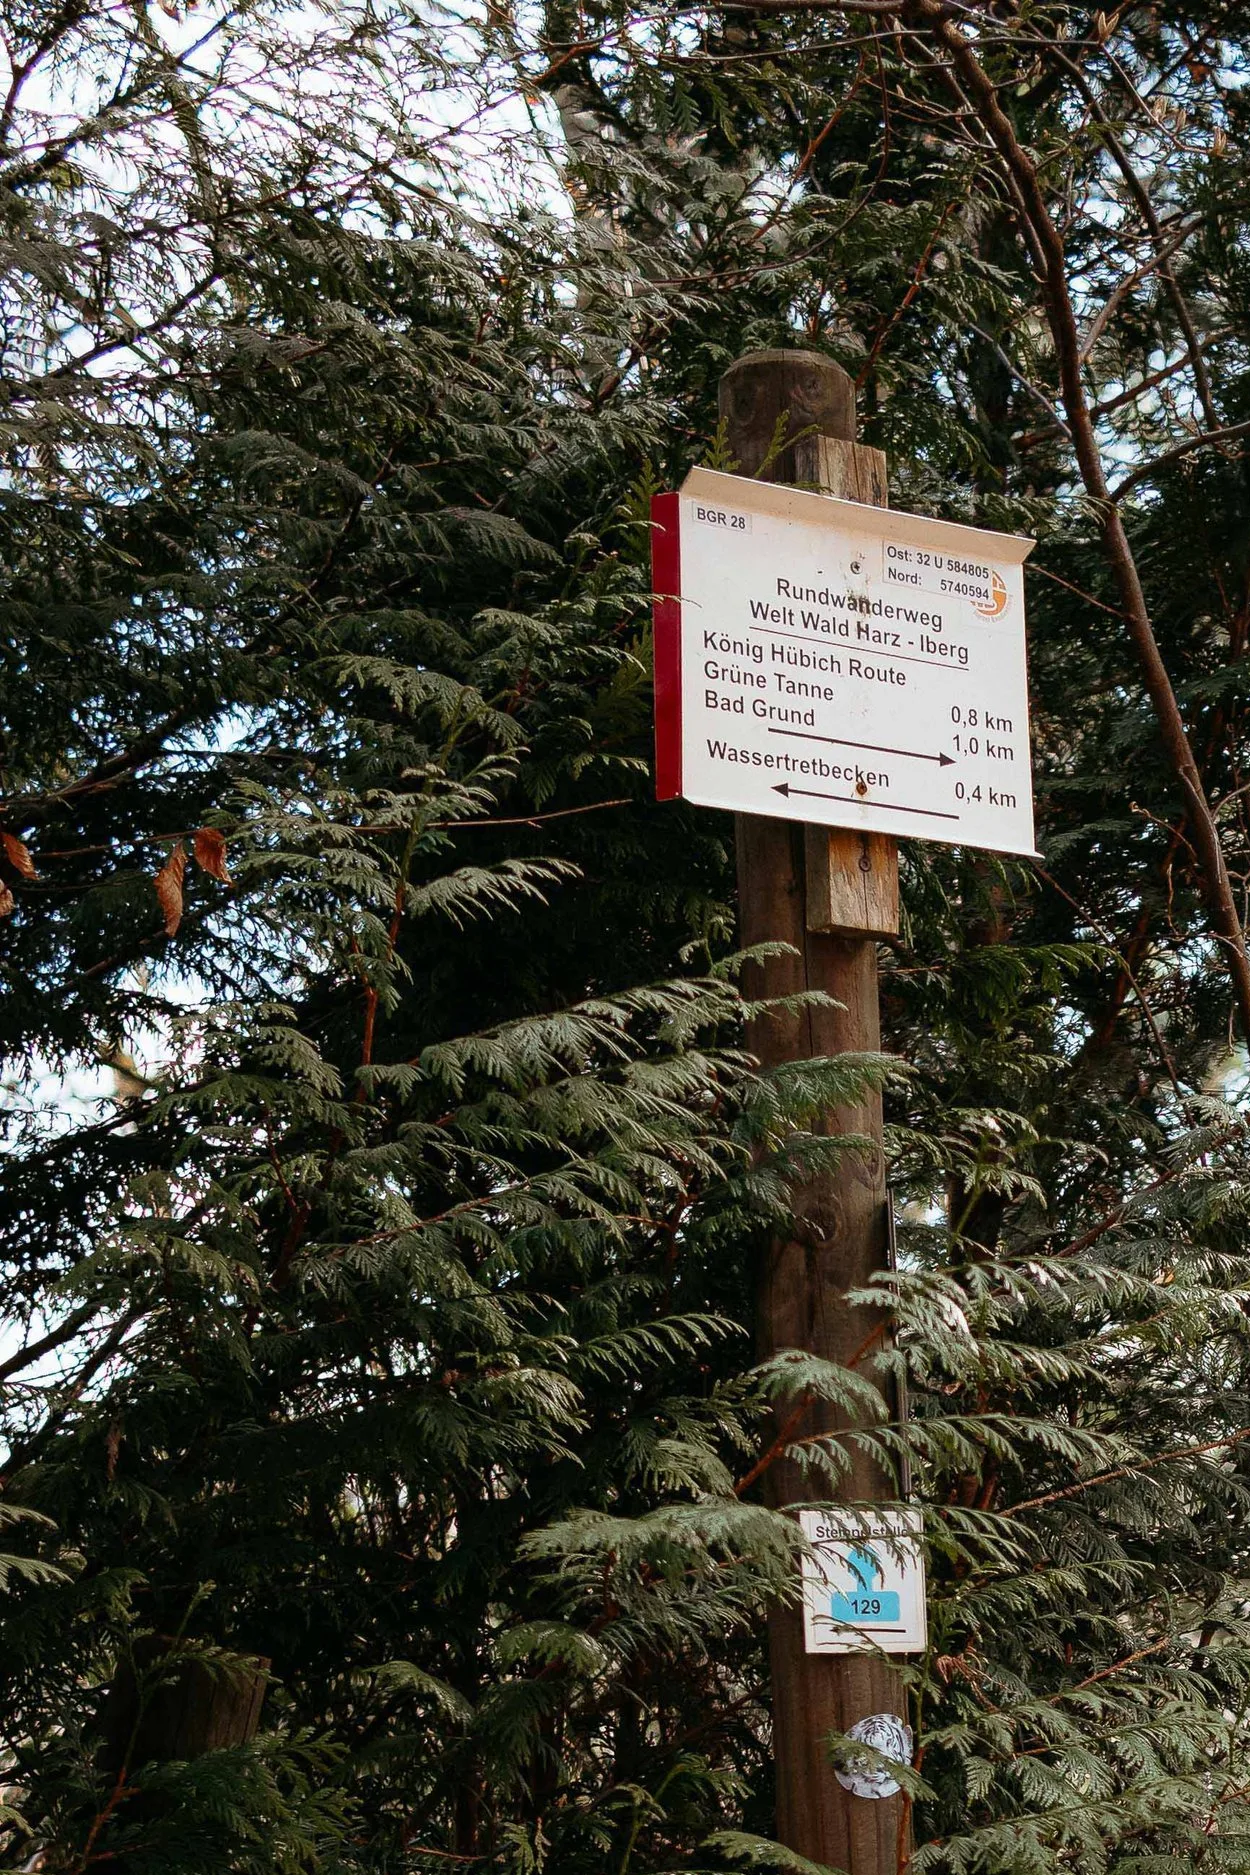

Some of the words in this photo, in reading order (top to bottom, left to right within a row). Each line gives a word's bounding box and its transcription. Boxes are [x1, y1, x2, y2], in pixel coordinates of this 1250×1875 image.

[697, 508, 726, 525] BGR
[731, 515, 746, 529] 28
[887, 546, 912, 562] Ost:
[917, 552, 930, 566] 32
[934, 556, 943, 568] U
[947, 560, 989, 579] 584805
[888, 567, 922, 585] Nord:
[940, 579, 989, 600] 5740594
[777, 578, 942, 631] Rundwanderweg
[704, 630, 763, 663] König
[771, 643, 841, 673] Hübich
[850, 658, 906, 685] Route
[750, 600, 795, 626] Welt
[801, 611, 849, 637] Wald
[857, 621, 900, 647] Harz
[920, 634, 969, 664] Iberg
[704, 660, 767, 688] Grüne
[774, 672, 834, 701] Tanne
[951, 705, 978, 728] 0,8
[985, 712, 1013, 733] km
[705, 690, 744, 714] Bad
[752, 702, 815, 727] Grund
[952, 734, 979, 756] 1,0
[986, 740, 1014, 761] km
[707, 739, 890, 787] Wassertretbecken
[955, 782, 982, 804] 0,4
[989, 787, 1017, 808] km
[851, 1599, 881, 1615] 129
